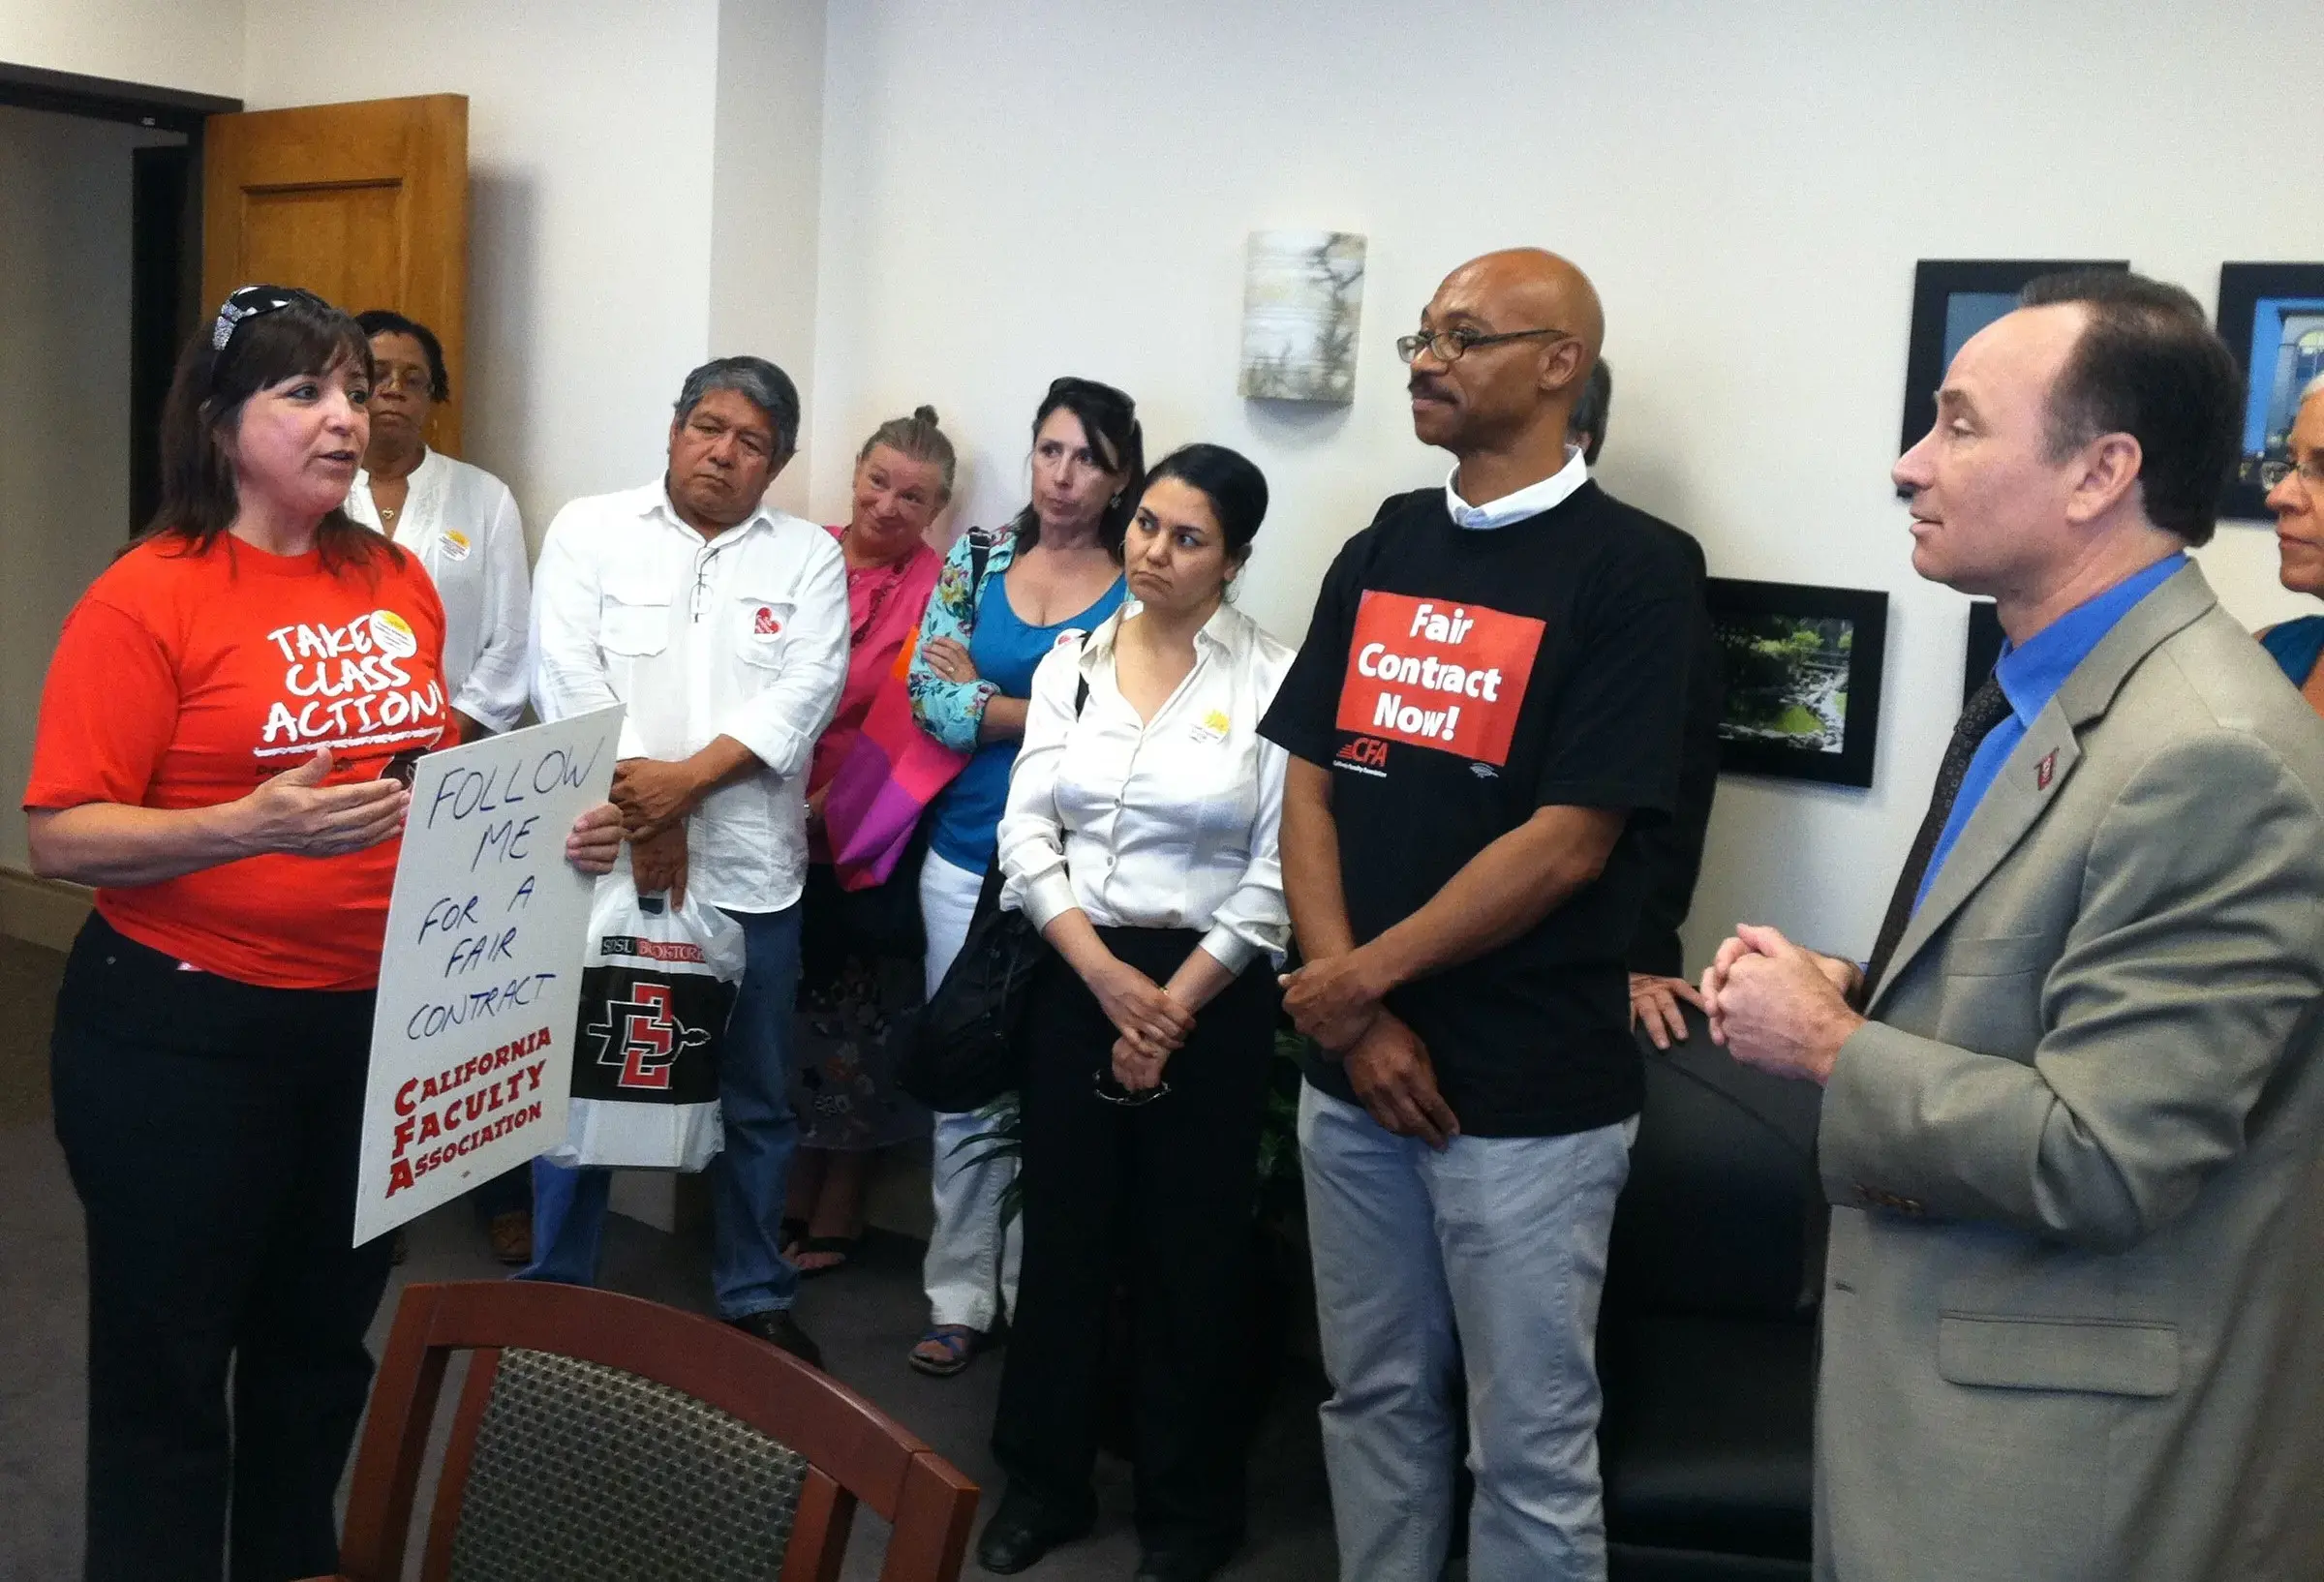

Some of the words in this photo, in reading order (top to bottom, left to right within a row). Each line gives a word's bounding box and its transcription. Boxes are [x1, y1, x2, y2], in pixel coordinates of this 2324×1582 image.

[267, 614, 372, 663] TAKE
[1410, 603, 1474, 645] Fair
[286, 653, 411, 697] CLASS
[1358, 643, 1502, 702] Contract
[262, 680, 446, 743] ACTION!
[1372, 692, 1460, 742] Now!
[1350, 737, 1390, 768] CFA
[427, 736, 605, 830] FOLLOW
[472, 815, 540, 872] ME
[417, 895, 479, 946] FOR
[506, 874, 535, 913] A
[444, 927, 517, 979] FAIR
[407, 973, 557, 1041] CONTRACT
[394, 1026, 552, 1117] CALIFORNIA
[391, 1058, 547, 1160] FACULTY
[384, 1101, 542, 1200] ASSOCIATION
